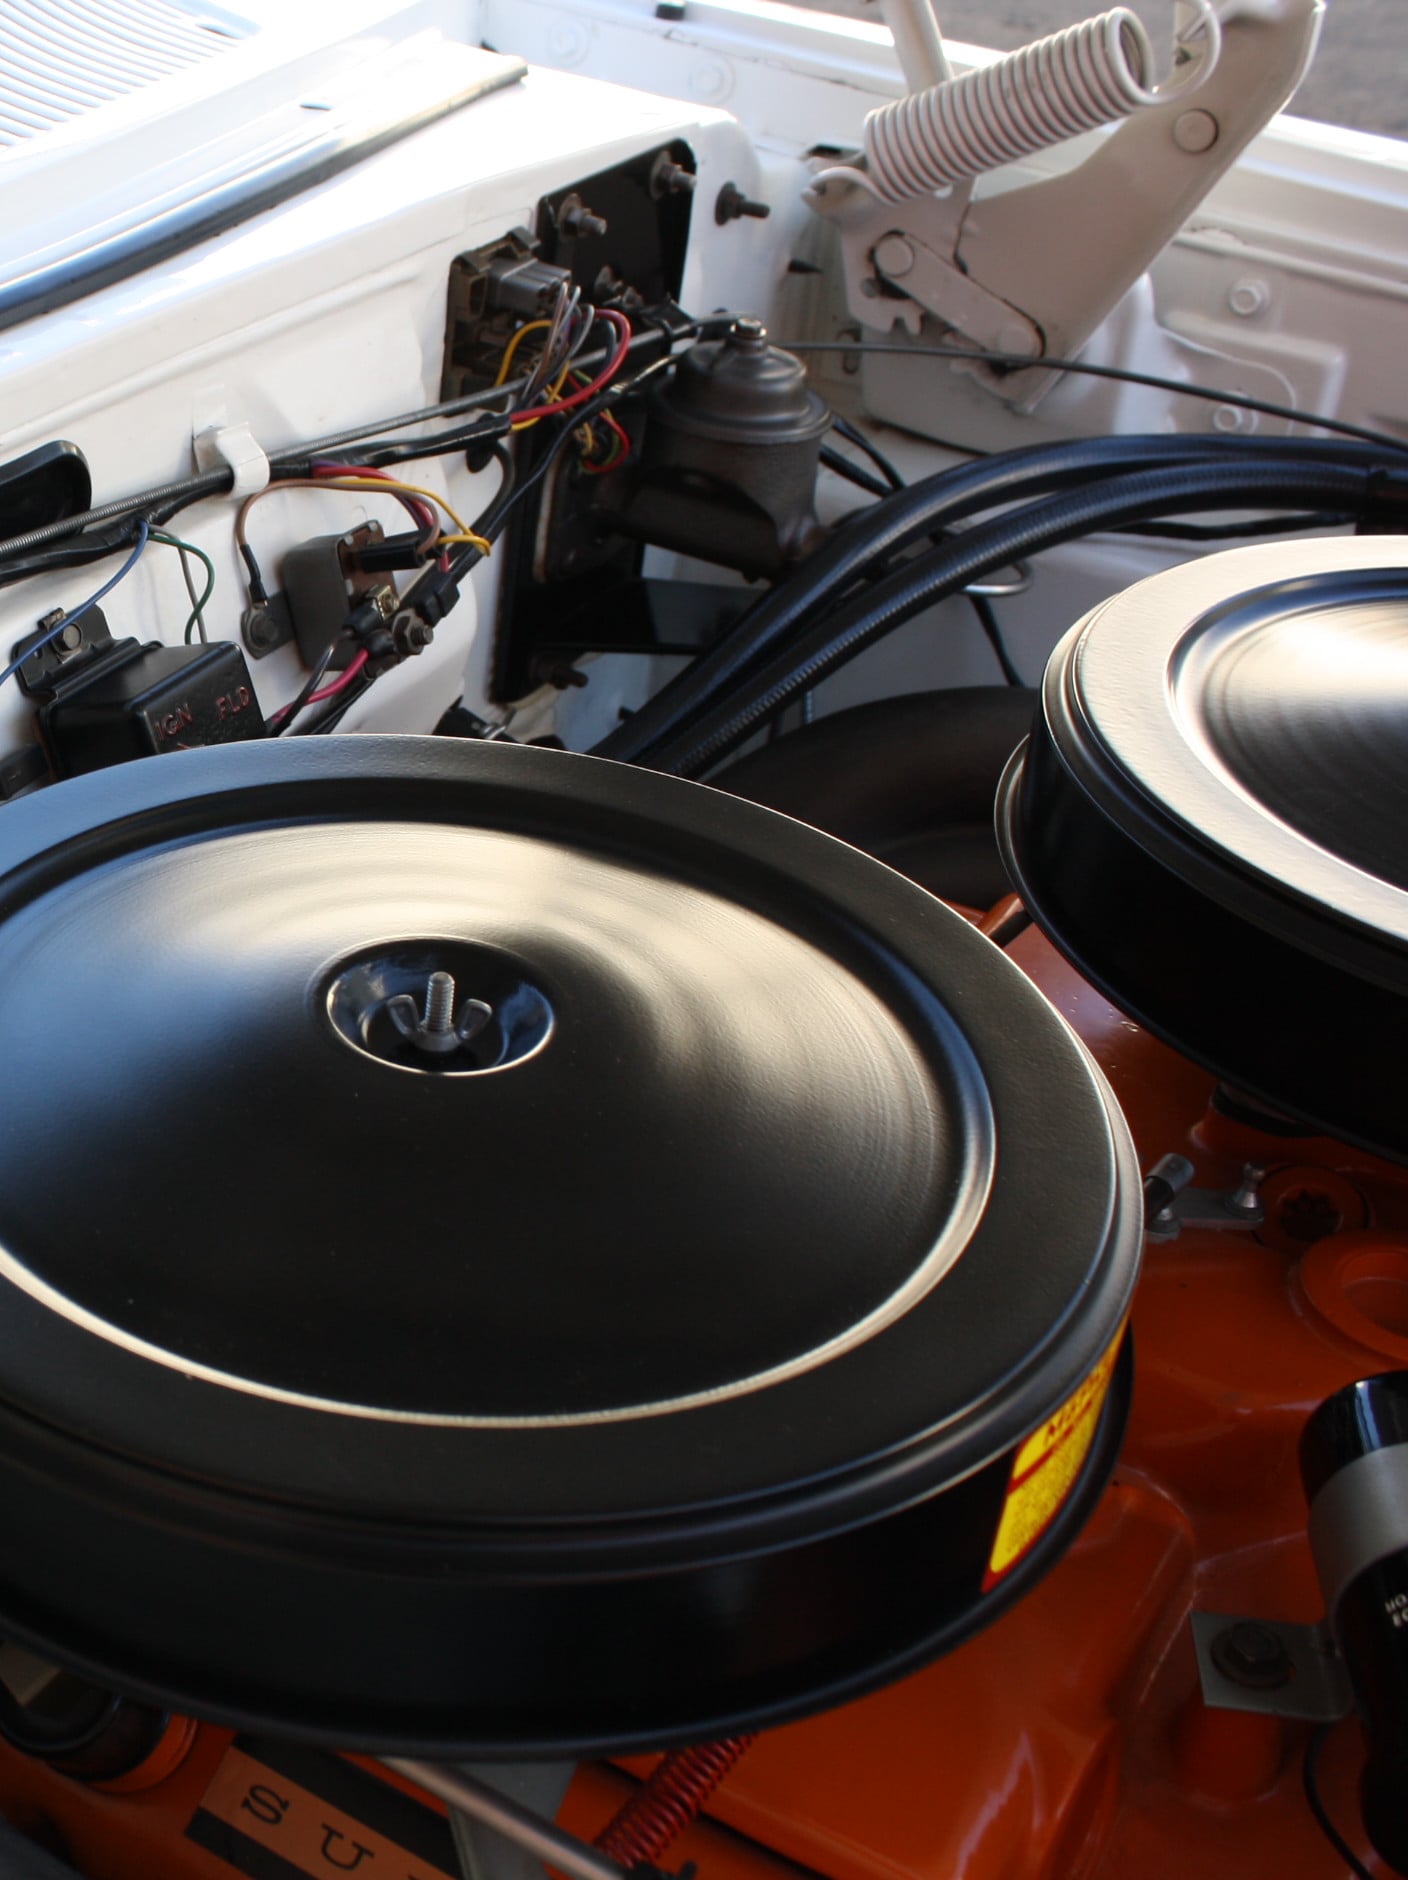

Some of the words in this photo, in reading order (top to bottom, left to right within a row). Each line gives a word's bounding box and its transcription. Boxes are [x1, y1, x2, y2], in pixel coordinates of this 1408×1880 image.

[155, 703, 193, 740] IGN
[217, 686, 251, 719] FLD
[241, 1785, 420, 1880] SU
